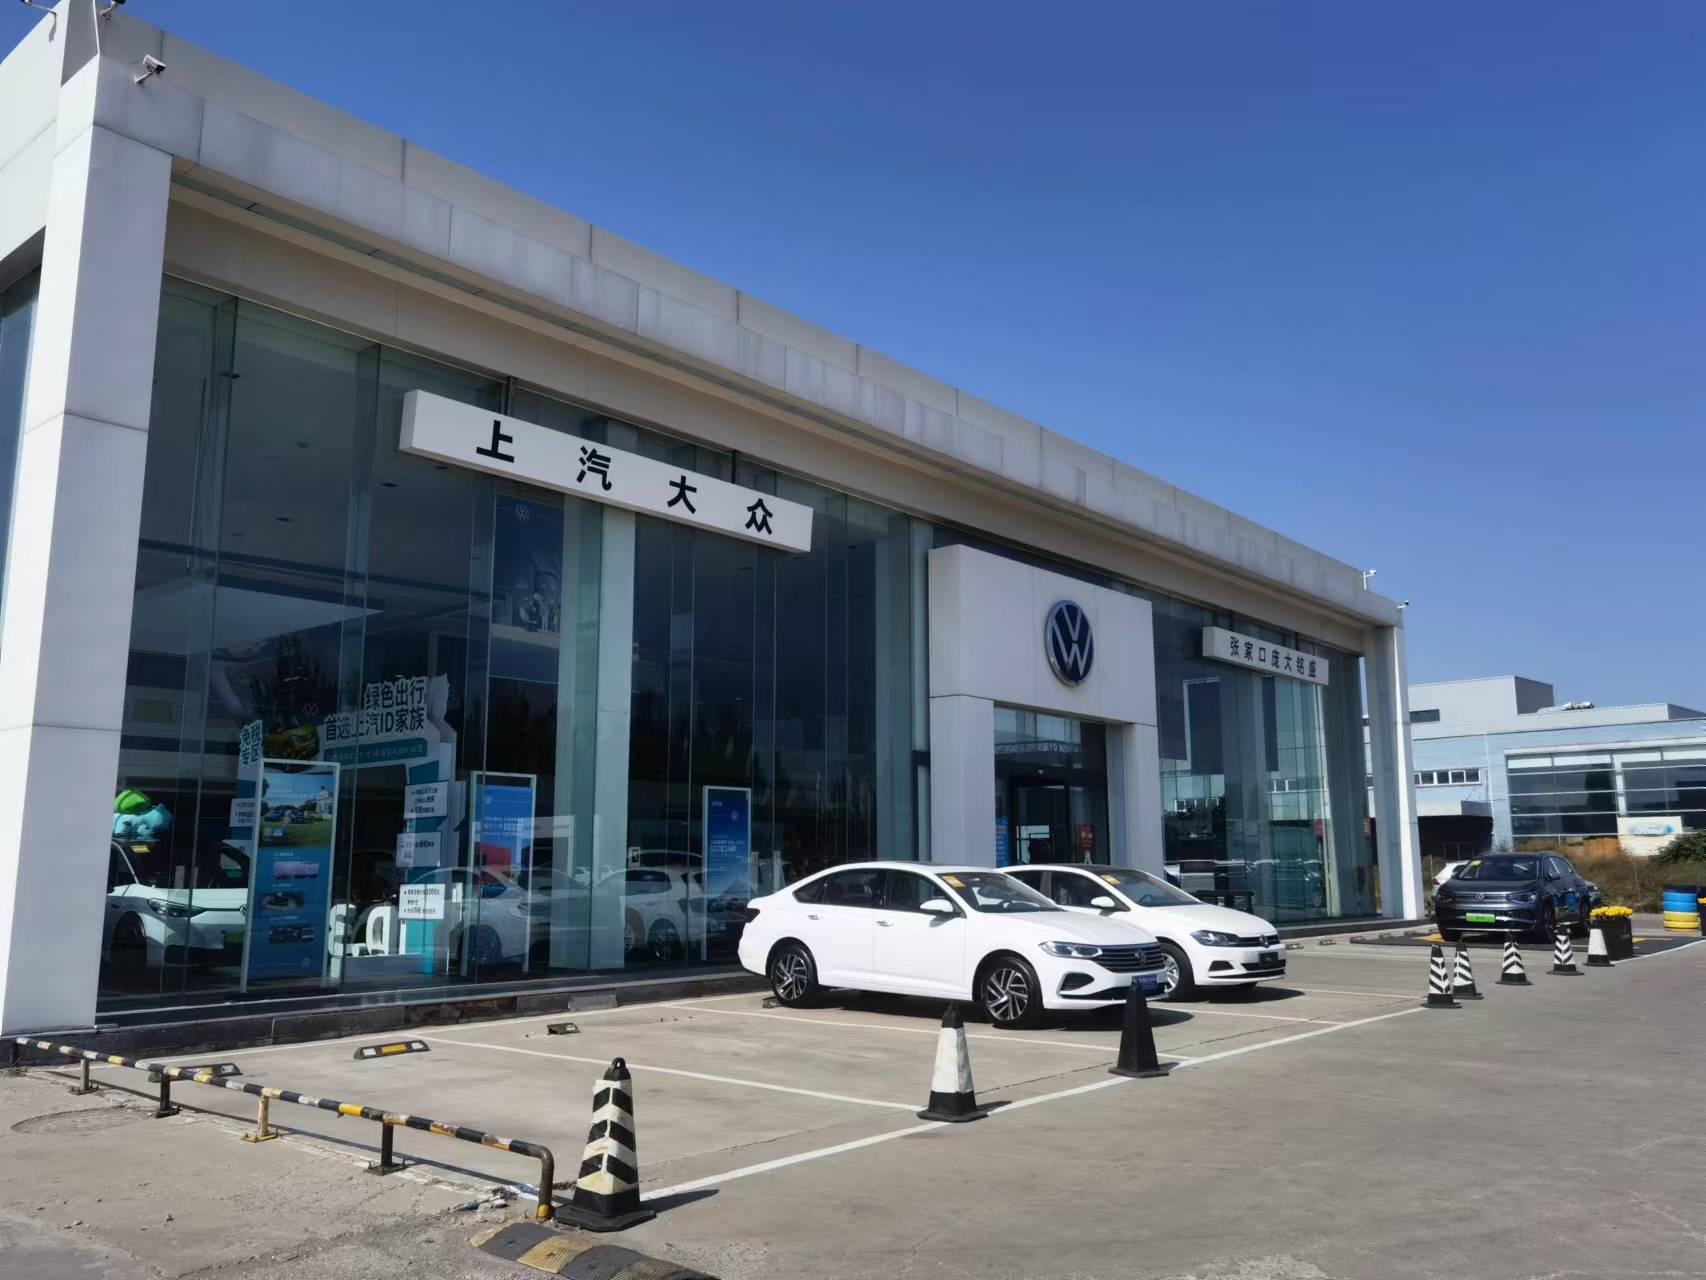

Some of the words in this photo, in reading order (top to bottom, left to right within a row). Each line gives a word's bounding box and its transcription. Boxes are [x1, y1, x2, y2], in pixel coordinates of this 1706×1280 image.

[476, 420, 773, 536] 上汽大众
[365, 678, 425, 711] 绿色出行
